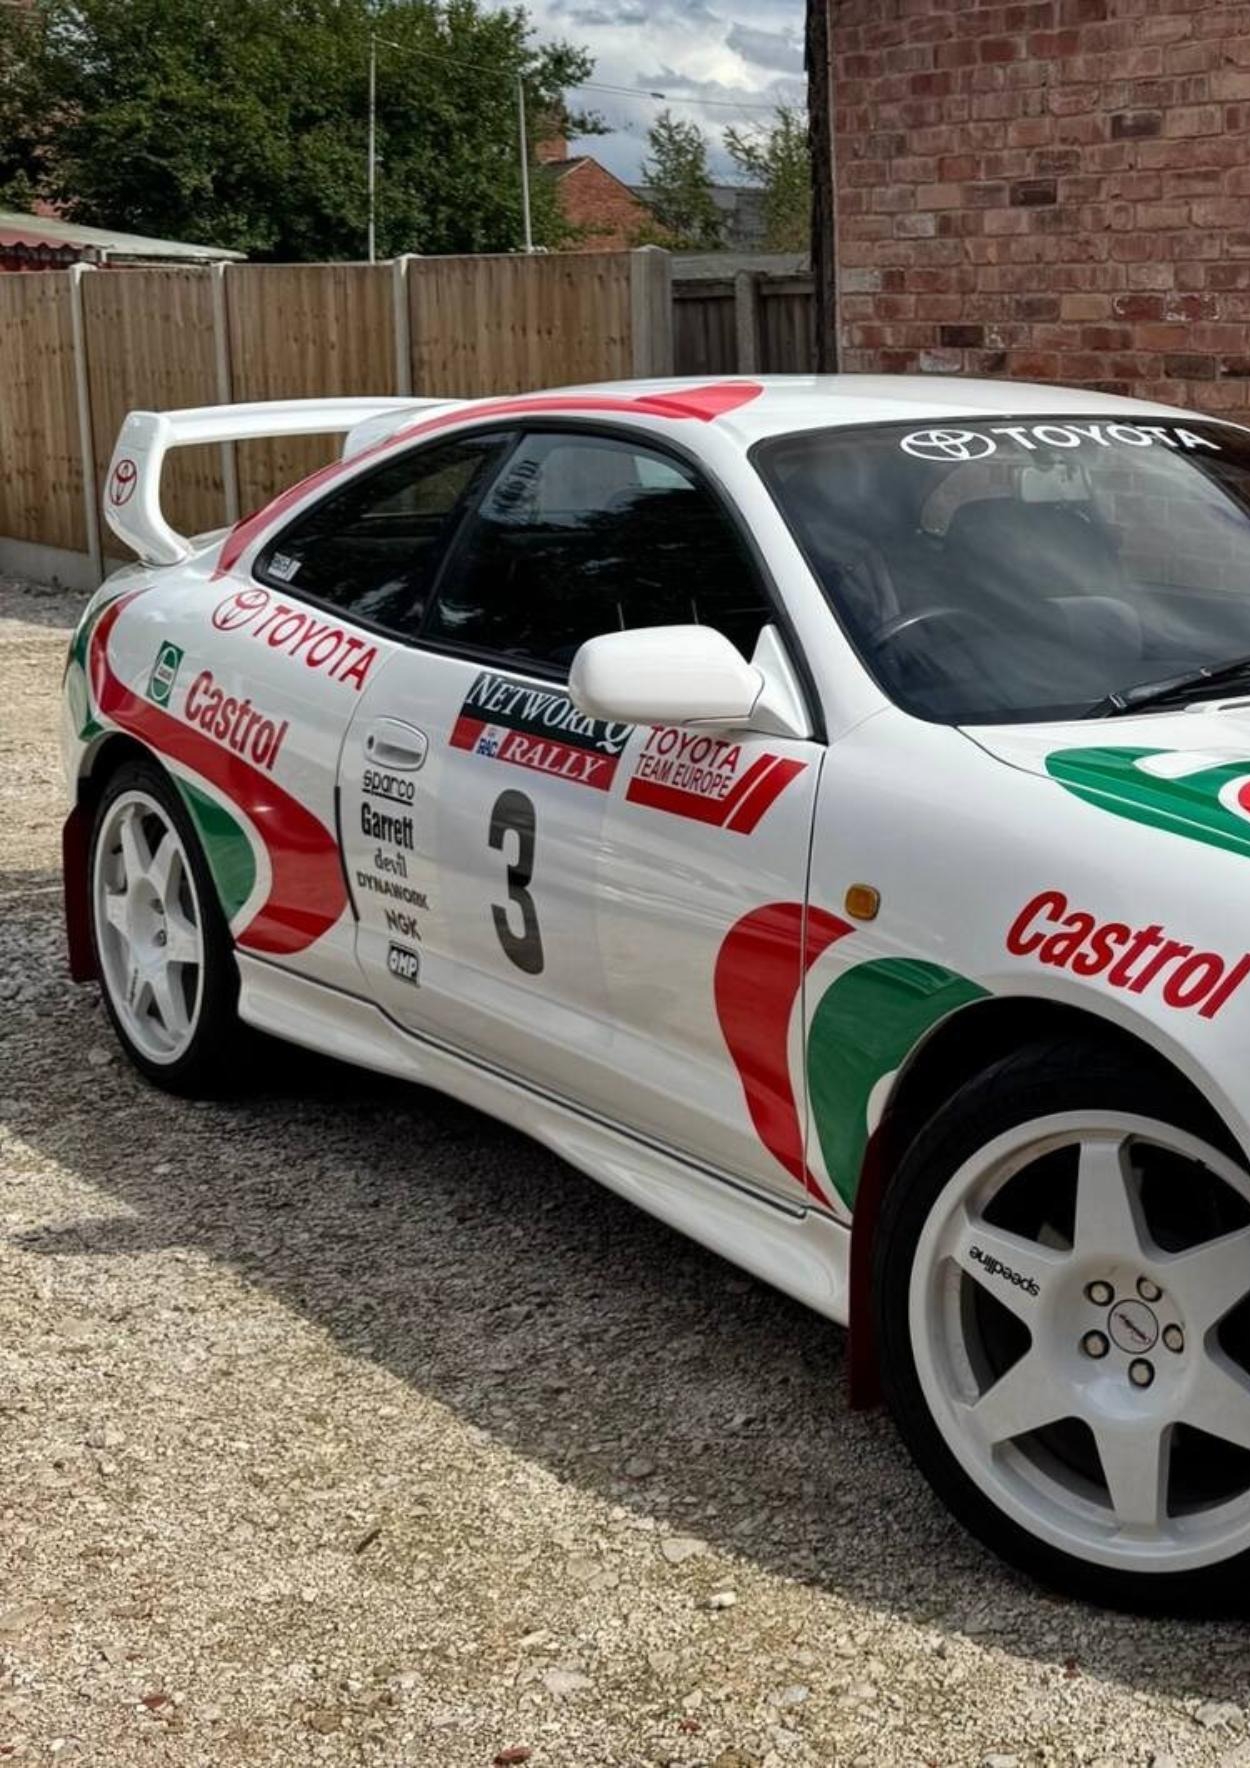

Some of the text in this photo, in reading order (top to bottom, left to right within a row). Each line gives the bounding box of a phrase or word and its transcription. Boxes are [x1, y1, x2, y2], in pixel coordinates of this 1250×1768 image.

[990, 425, 1222, 450] TOYOTA
[253, 605, 379, 691] TOYOTA
[184, 670, 289, 771] Castrol
[503, 736, 607, 783] RALLY
[643, 725, 742, 774] TOYOTA
[363, 769, 416, 800] sparco
[635, 754, 733, 798] TEAM EUROPE
[361, 802, 415, 851] Garrett
[374, 847, 408, 879] devil
[488, 788, 545, 975] 3
[384, 908, 421, 941] NGK
[969, 1245, 1041, 1298] speedline
